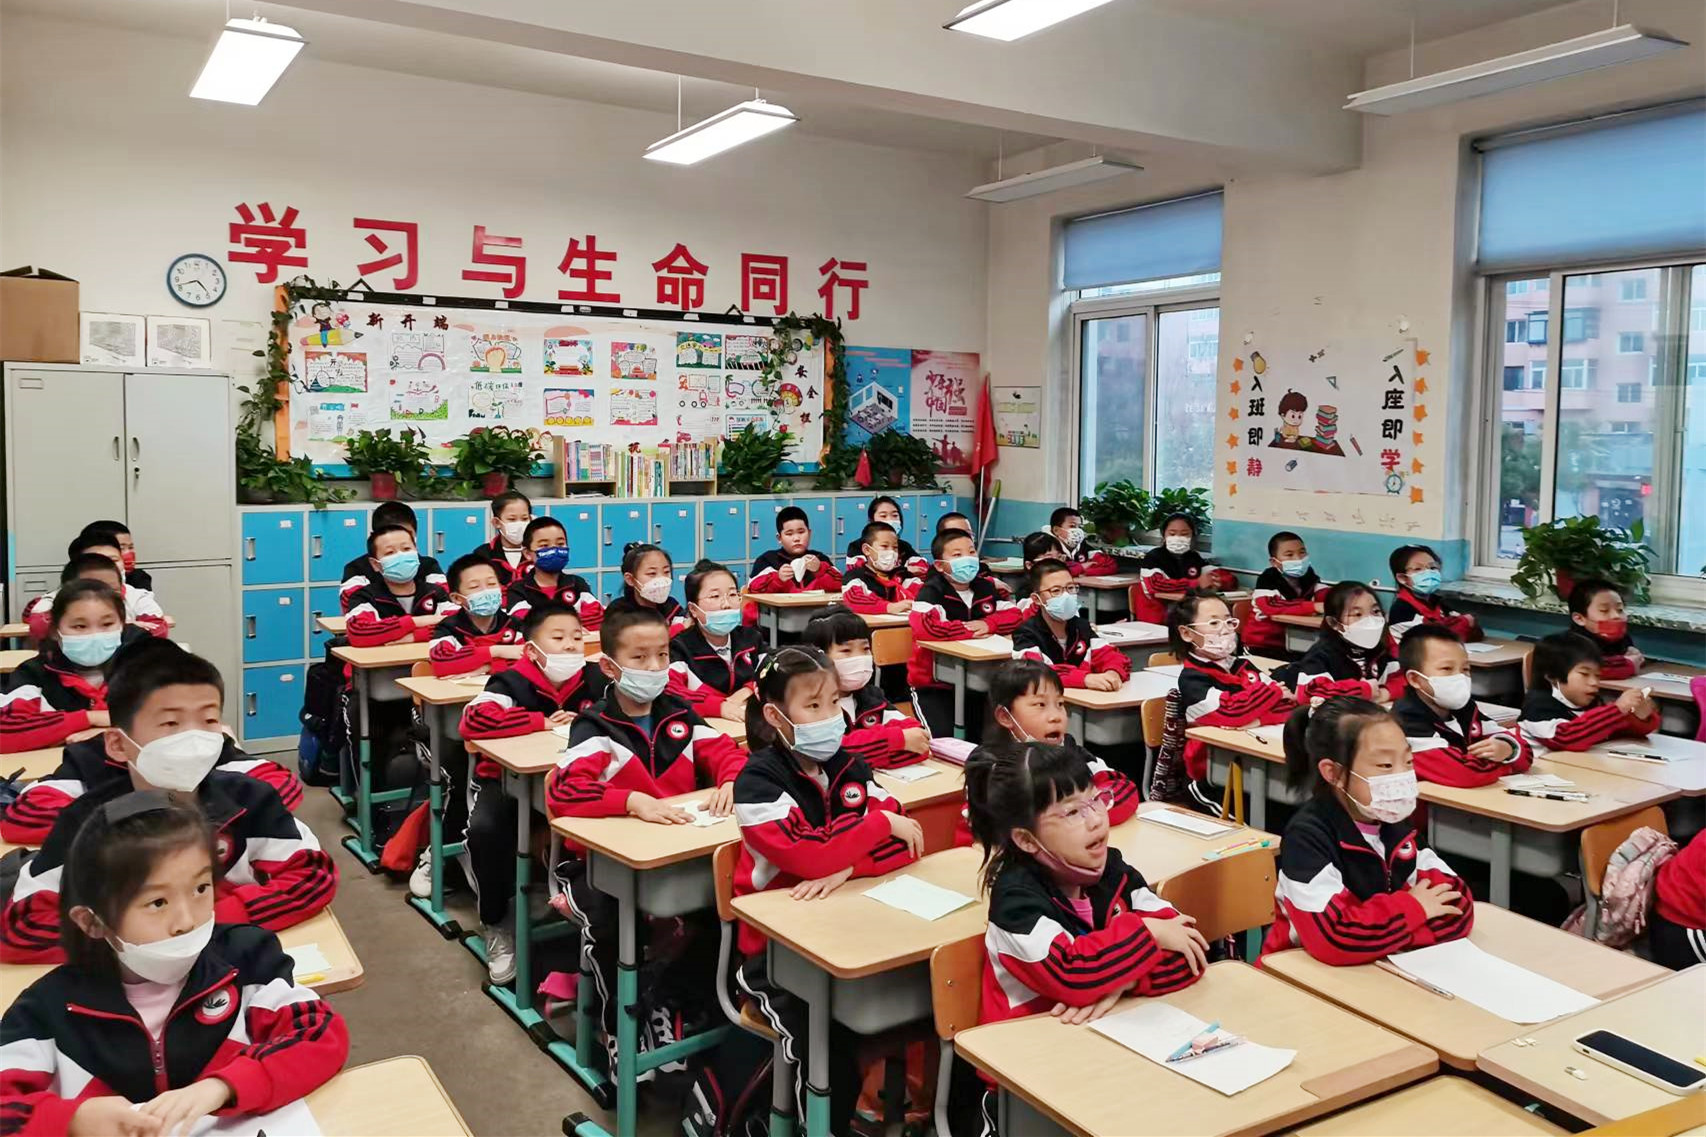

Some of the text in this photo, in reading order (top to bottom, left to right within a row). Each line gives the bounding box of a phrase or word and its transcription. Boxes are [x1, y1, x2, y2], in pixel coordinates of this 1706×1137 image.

[228, 202, 869, 320] 学习与生命同行
[366, 312, 449, 331] 新开端
[1246, 375, 1265, 477] 入班即静
[1381, 365, 1405, 472] 入座即学
